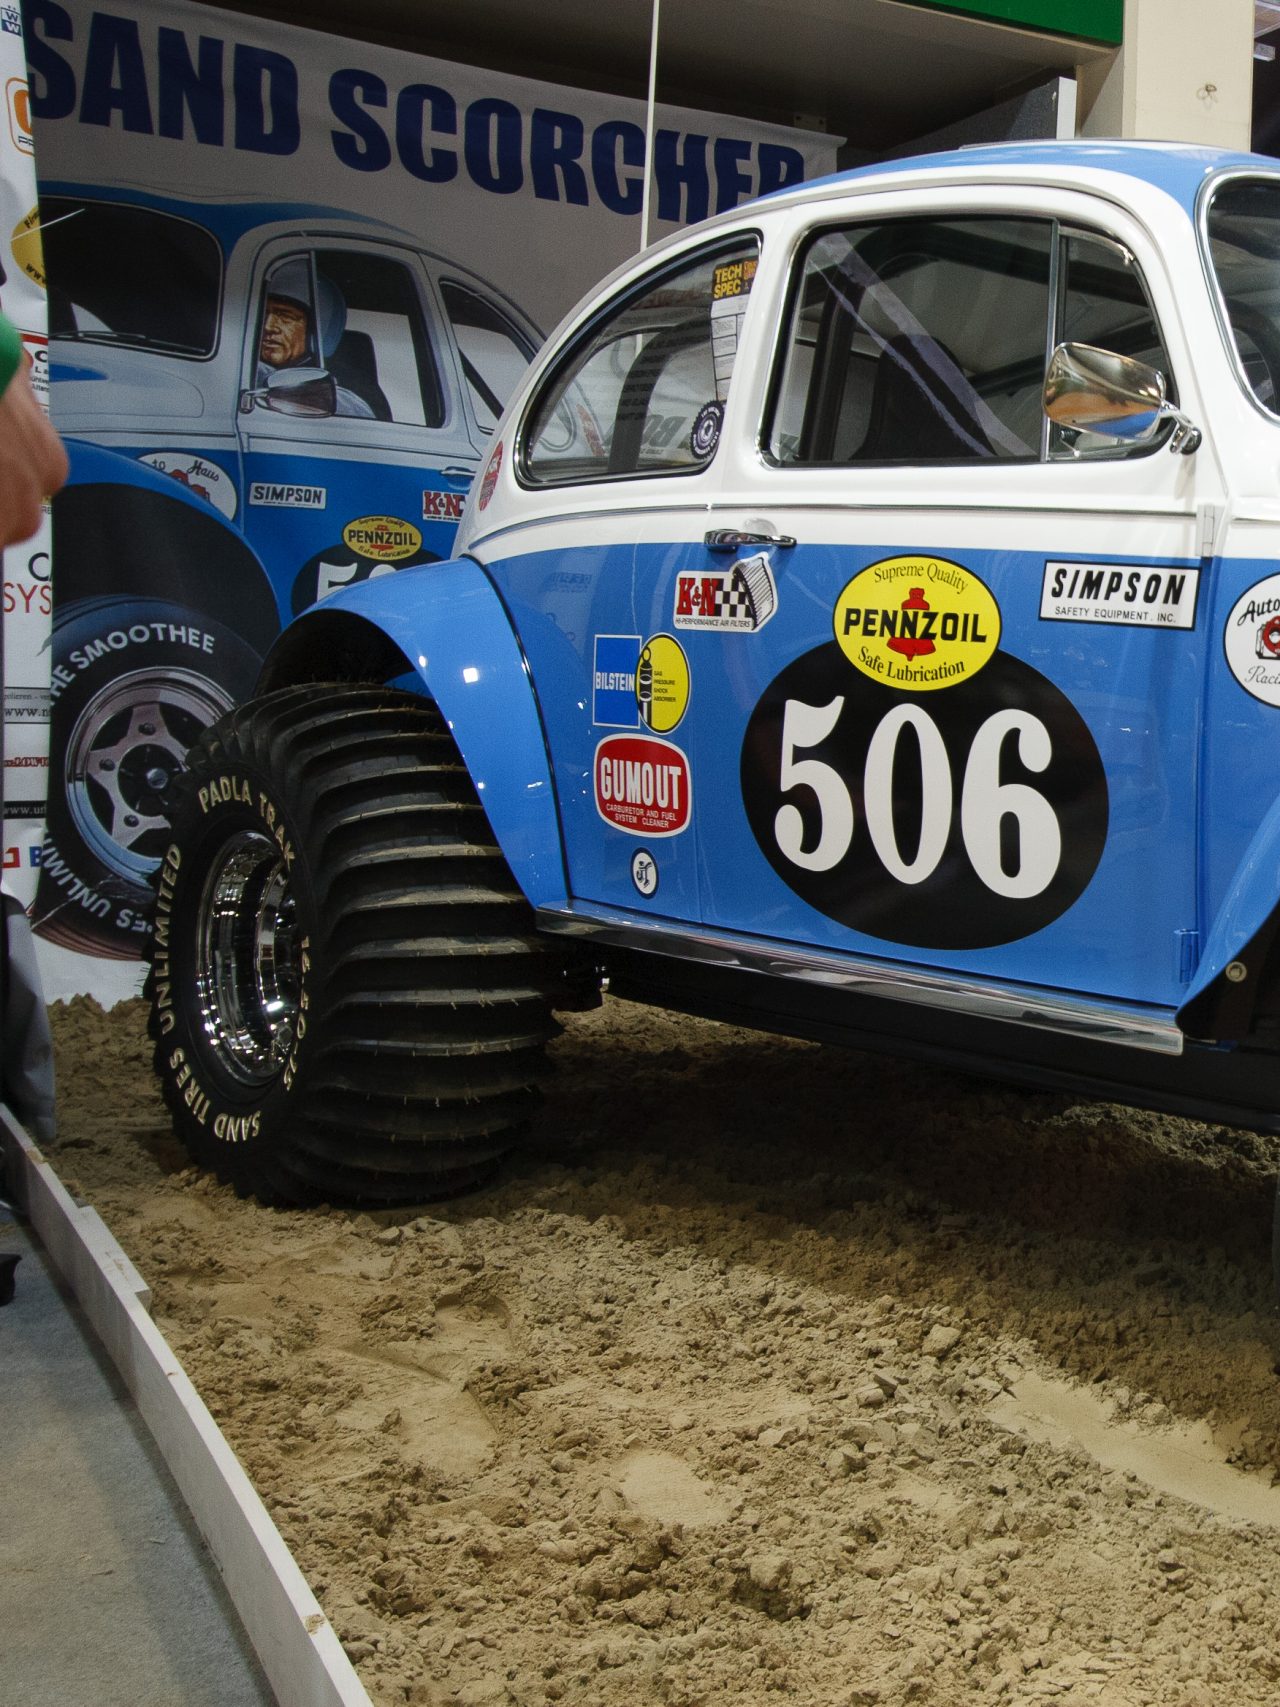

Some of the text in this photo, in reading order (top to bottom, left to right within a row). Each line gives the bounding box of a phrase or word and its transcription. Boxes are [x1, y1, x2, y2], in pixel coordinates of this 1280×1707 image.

[20, 0, 300, 155] SAND
[713, 279, 741, 299] SPEC
[715, 263, 743, 283] TECH
[253, 485, 322, 504] SIMPSON
[348, 529, 417, 546] PENNZOIL
[874, 562, 969, 594] Supreme Quality
[1051, 568, 1186, 605] SIMPSON
[676, 577, 719, 616] K&N
[1237, 598, 1280, 626] Auto
[843, 607, 987, 643] PENNZOIL
[1055, 606, 1090, 617] SAFETY
[1157, 612, 1176, 623] INC.
[50, 623, 215, 705] HE SMOOTHEE
[858, 646, 966, 682] Safe Lubrication
[595, 671, 635, 692] BILSTEIN
[601, 757, 682, 810] GUMOUT
[774, 695, 1062, 899] 506
[198, 775, 297, 872] PADLA TRAK
[605, 803, 677, 821] CARBURETOR AND FUEL
[614, 813, 669, 828] SYSTEM CLEANER
[154, 843, 262, 1142] SAND TIRES UNLIMITED
